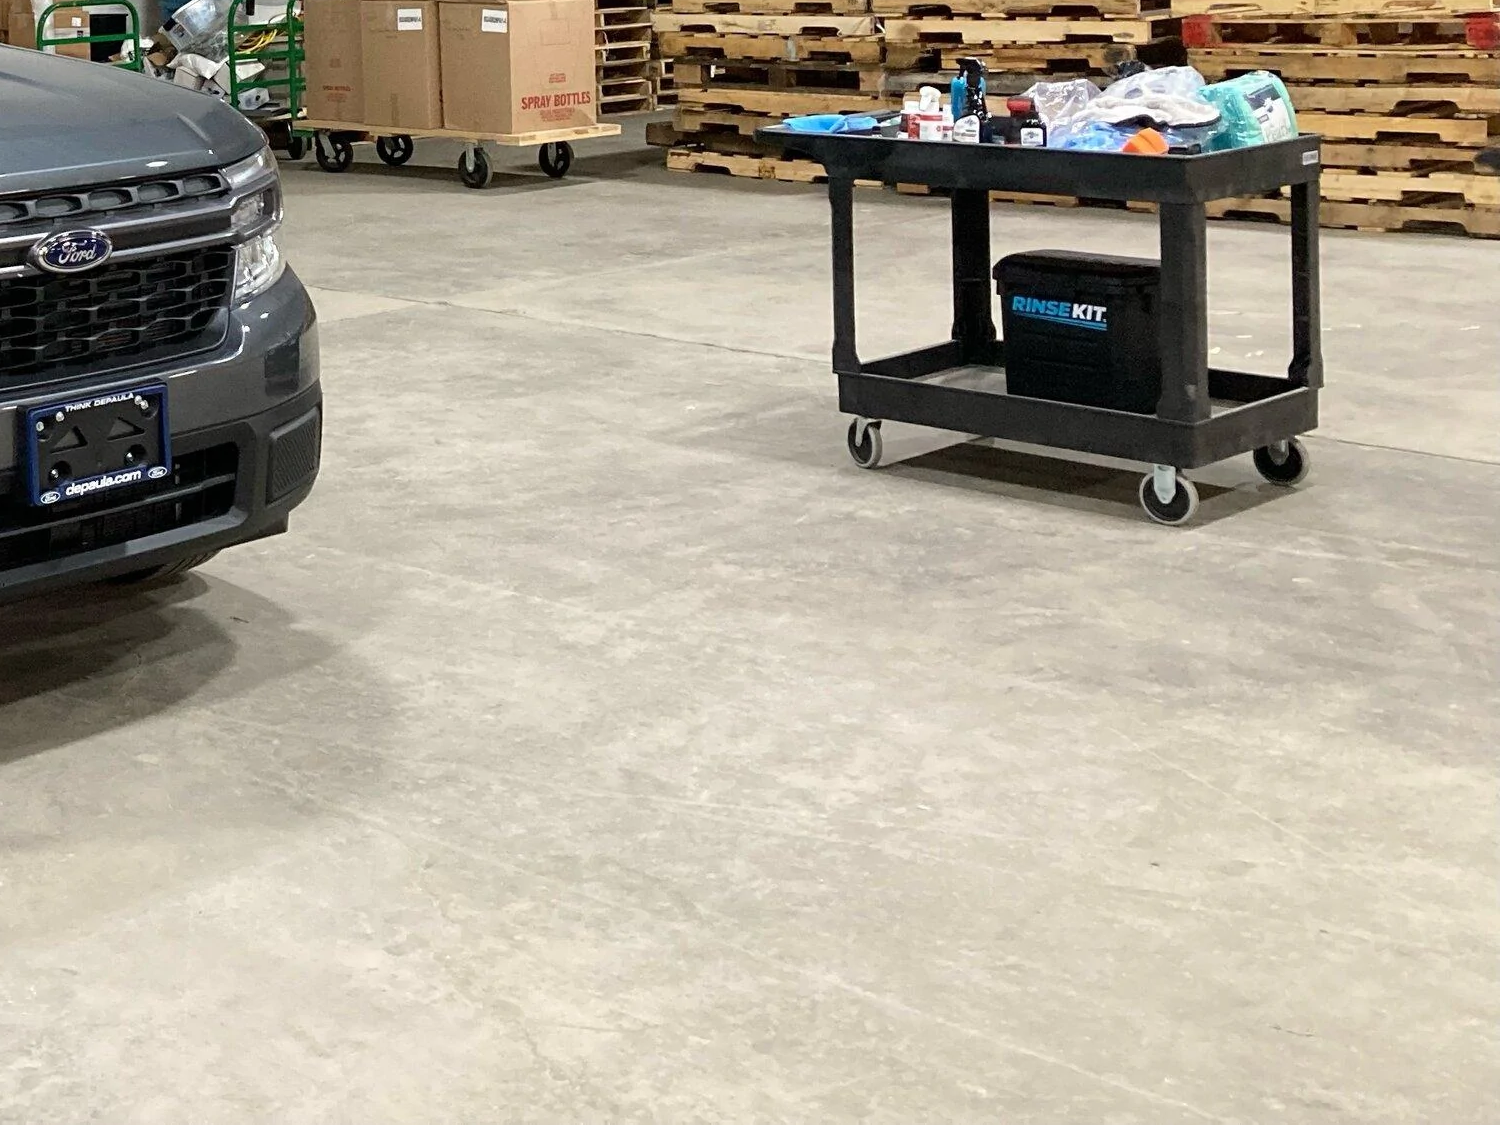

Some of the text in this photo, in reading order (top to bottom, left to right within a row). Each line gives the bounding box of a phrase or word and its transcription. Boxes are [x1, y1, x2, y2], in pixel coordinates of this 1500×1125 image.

[521, 91, 591, 110] SPRAY BOTTLES
[59, 241, 97, 264] Ford
[65, 392, 134, 412] THINK DEPAULA
[66, 470, 142, 495] depaula.com
